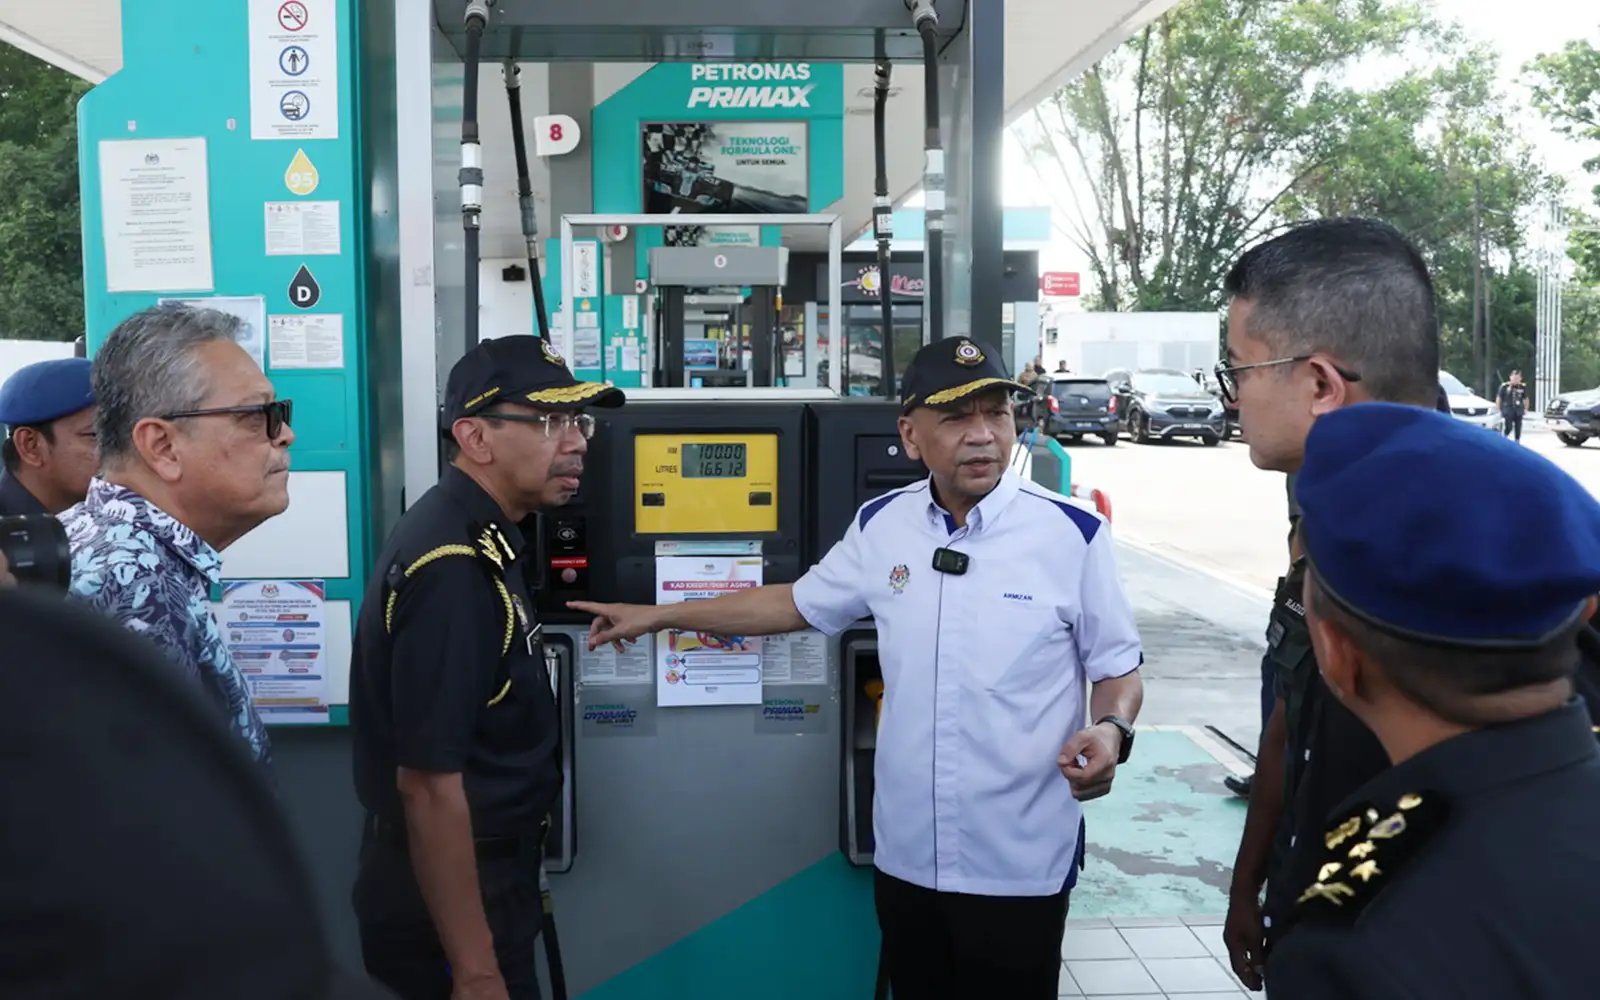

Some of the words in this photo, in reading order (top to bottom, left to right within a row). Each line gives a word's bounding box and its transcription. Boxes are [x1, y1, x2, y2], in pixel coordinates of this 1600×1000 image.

[691, 63, 811, 80] PETRONAS
[687, 84, 816, 108] PRIMAX
[550, 124, 563, 141] 8
[729, 137, 790, 145] TEKNOLOGI
[720, 146, 771, 155] FORMULA
[290, 173, 314, 188] 95
[297, 286, 311, 302] D
[655, 465, 678, 473] LITRES
